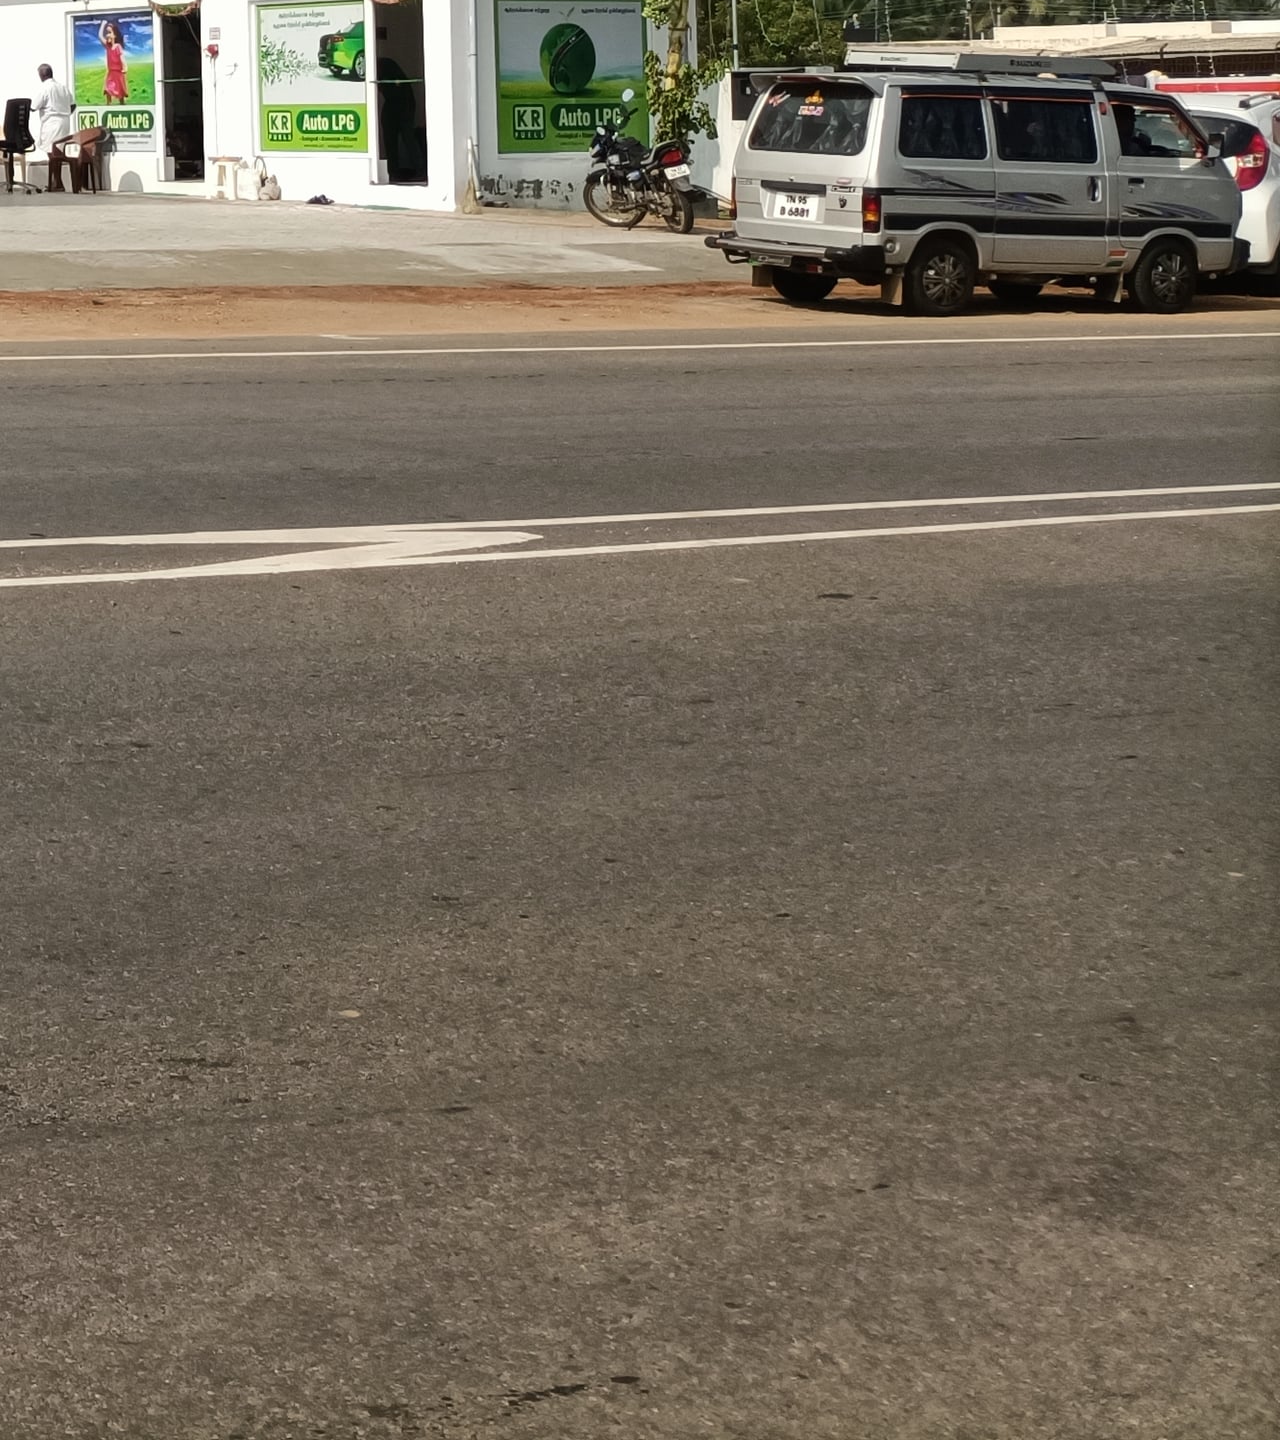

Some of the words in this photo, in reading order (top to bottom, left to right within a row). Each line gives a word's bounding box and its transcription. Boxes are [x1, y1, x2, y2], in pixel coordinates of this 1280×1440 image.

[80, 115, 96, 130] KR
[107, 113, 129, 129] Auto
[131, 113, 150, 129] LPG
[270, 114, 289, 131] KR
[302, 113, 329, 131] Auto
[332, 113, 355, 131] LPG
[517, 109, 541, 128] KR
[558, 107, 591, 127] Auto
[786, 195, 796, 204] TN
[779, 206, 786, 216] B
